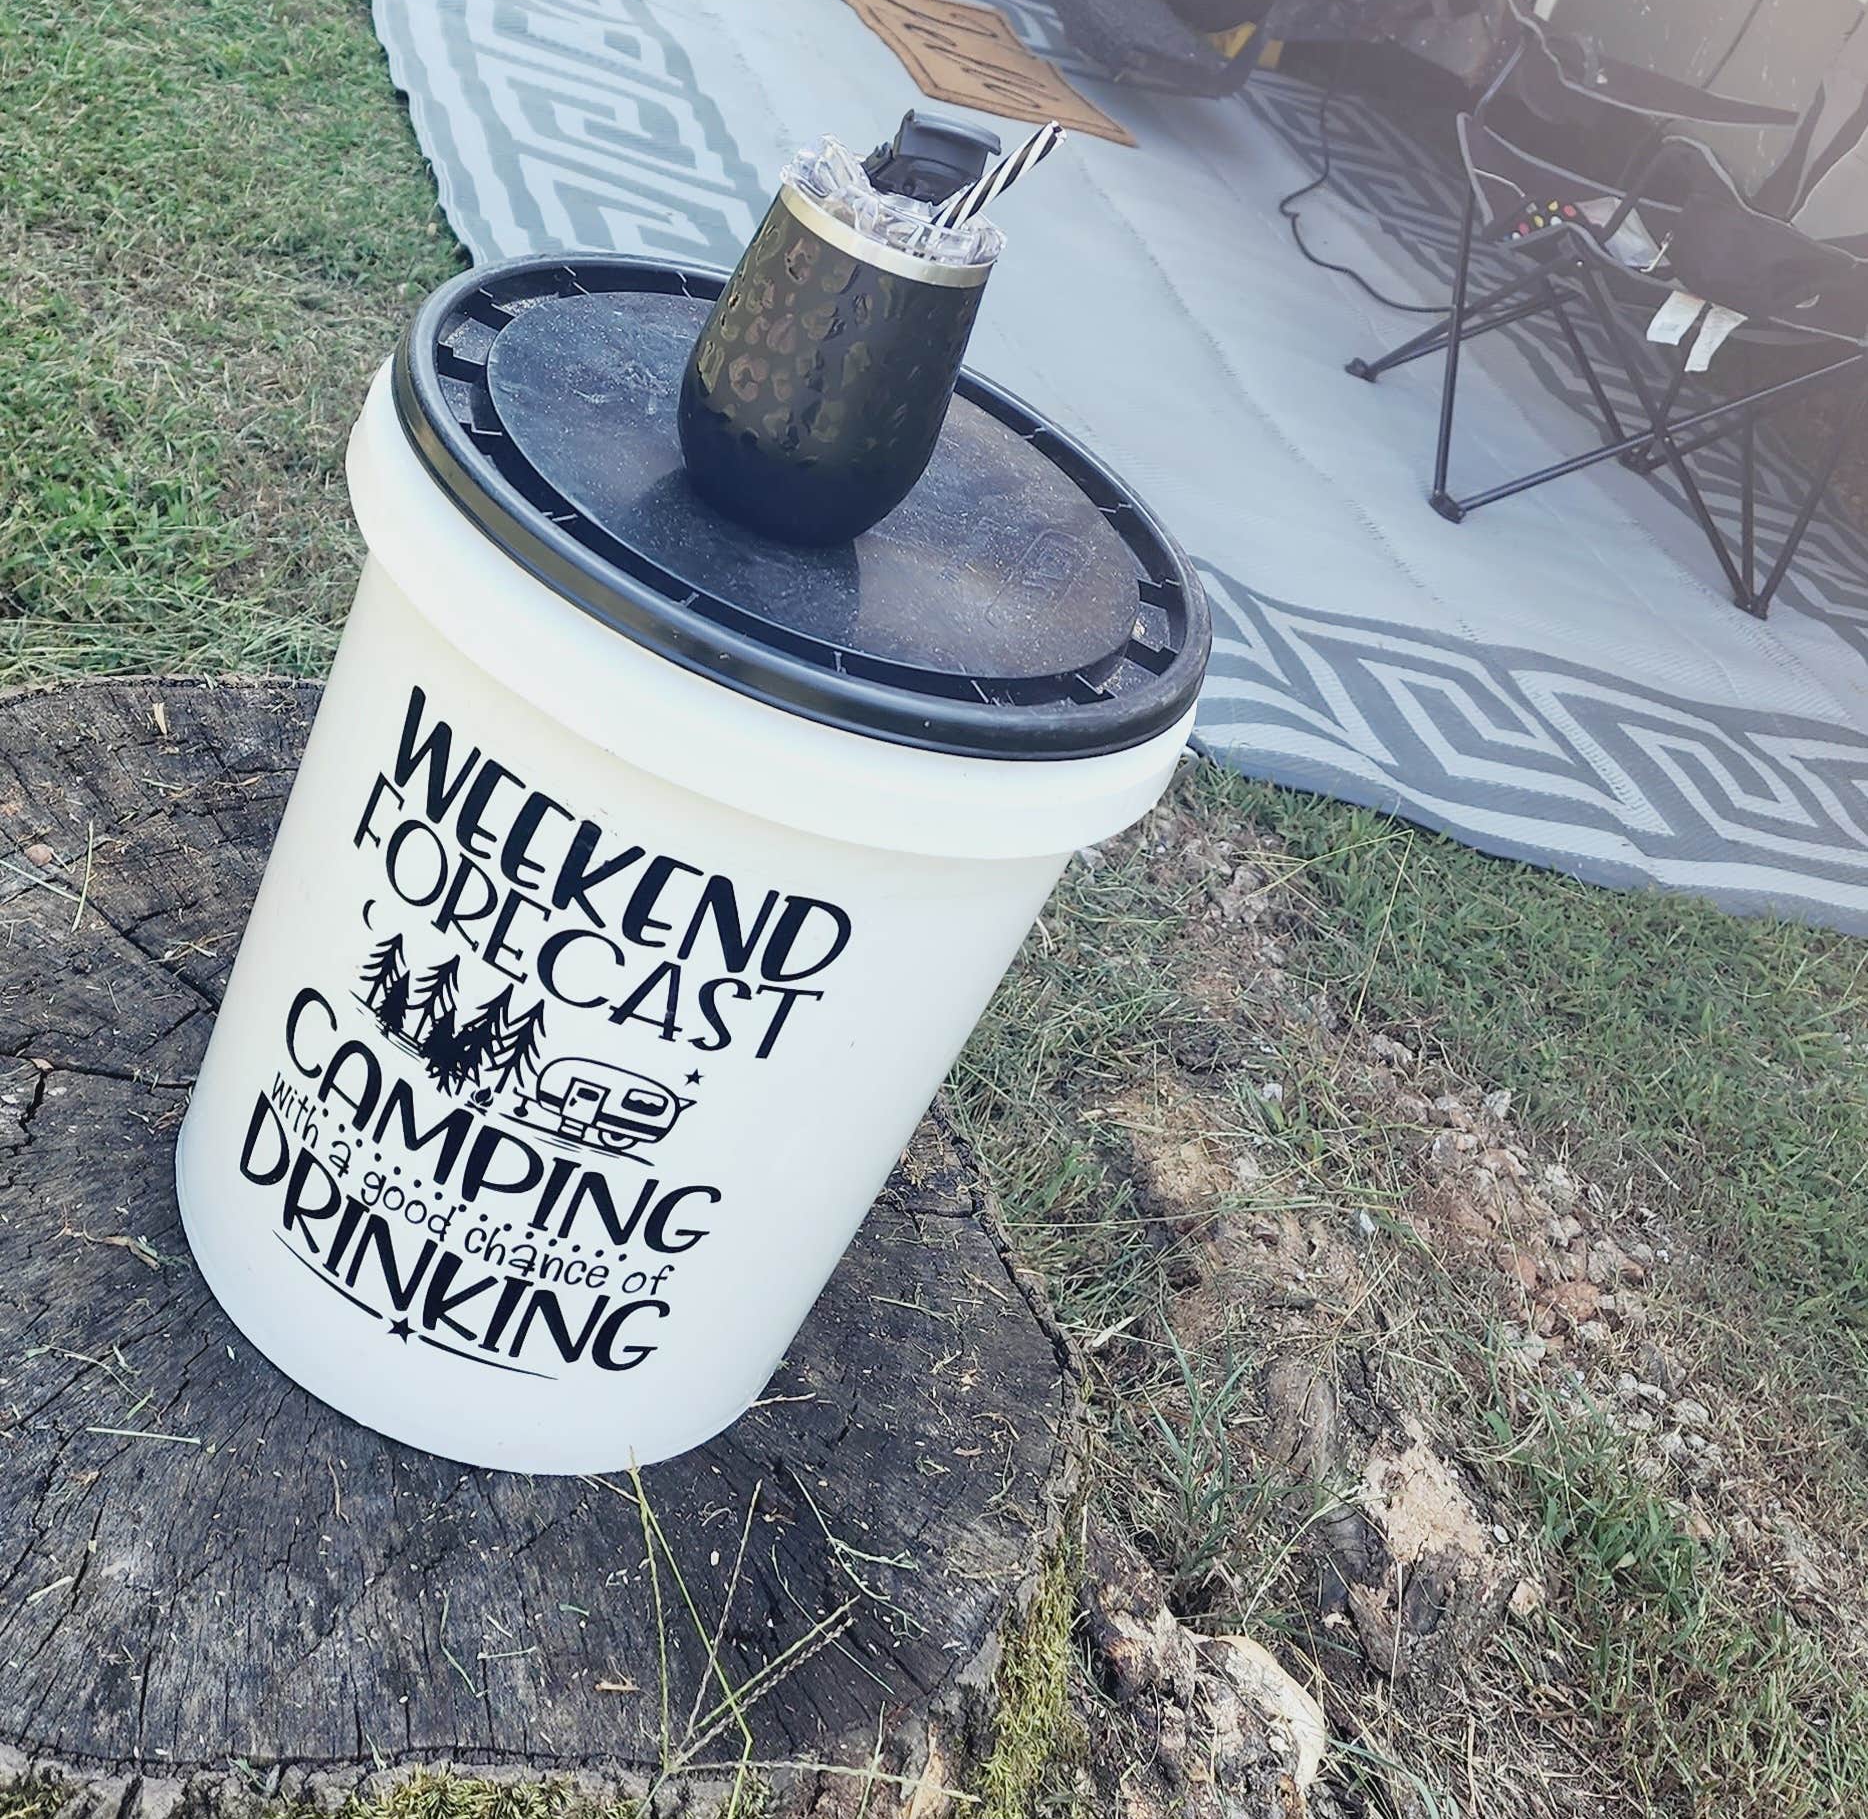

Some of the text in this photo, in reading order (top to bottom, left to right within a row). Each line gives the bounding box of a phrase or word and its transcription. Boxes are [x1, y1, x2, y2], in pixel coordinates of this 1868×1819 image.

[353, 771, 824, 1060] FORECAST
[393, 685, 853, 984] WEEKEND
[239, 1090, 671, 1373] DRINKING
[270, 1072, 675, 1296] with a good chance of
[285, 987, 722, 1255] CAMPING
